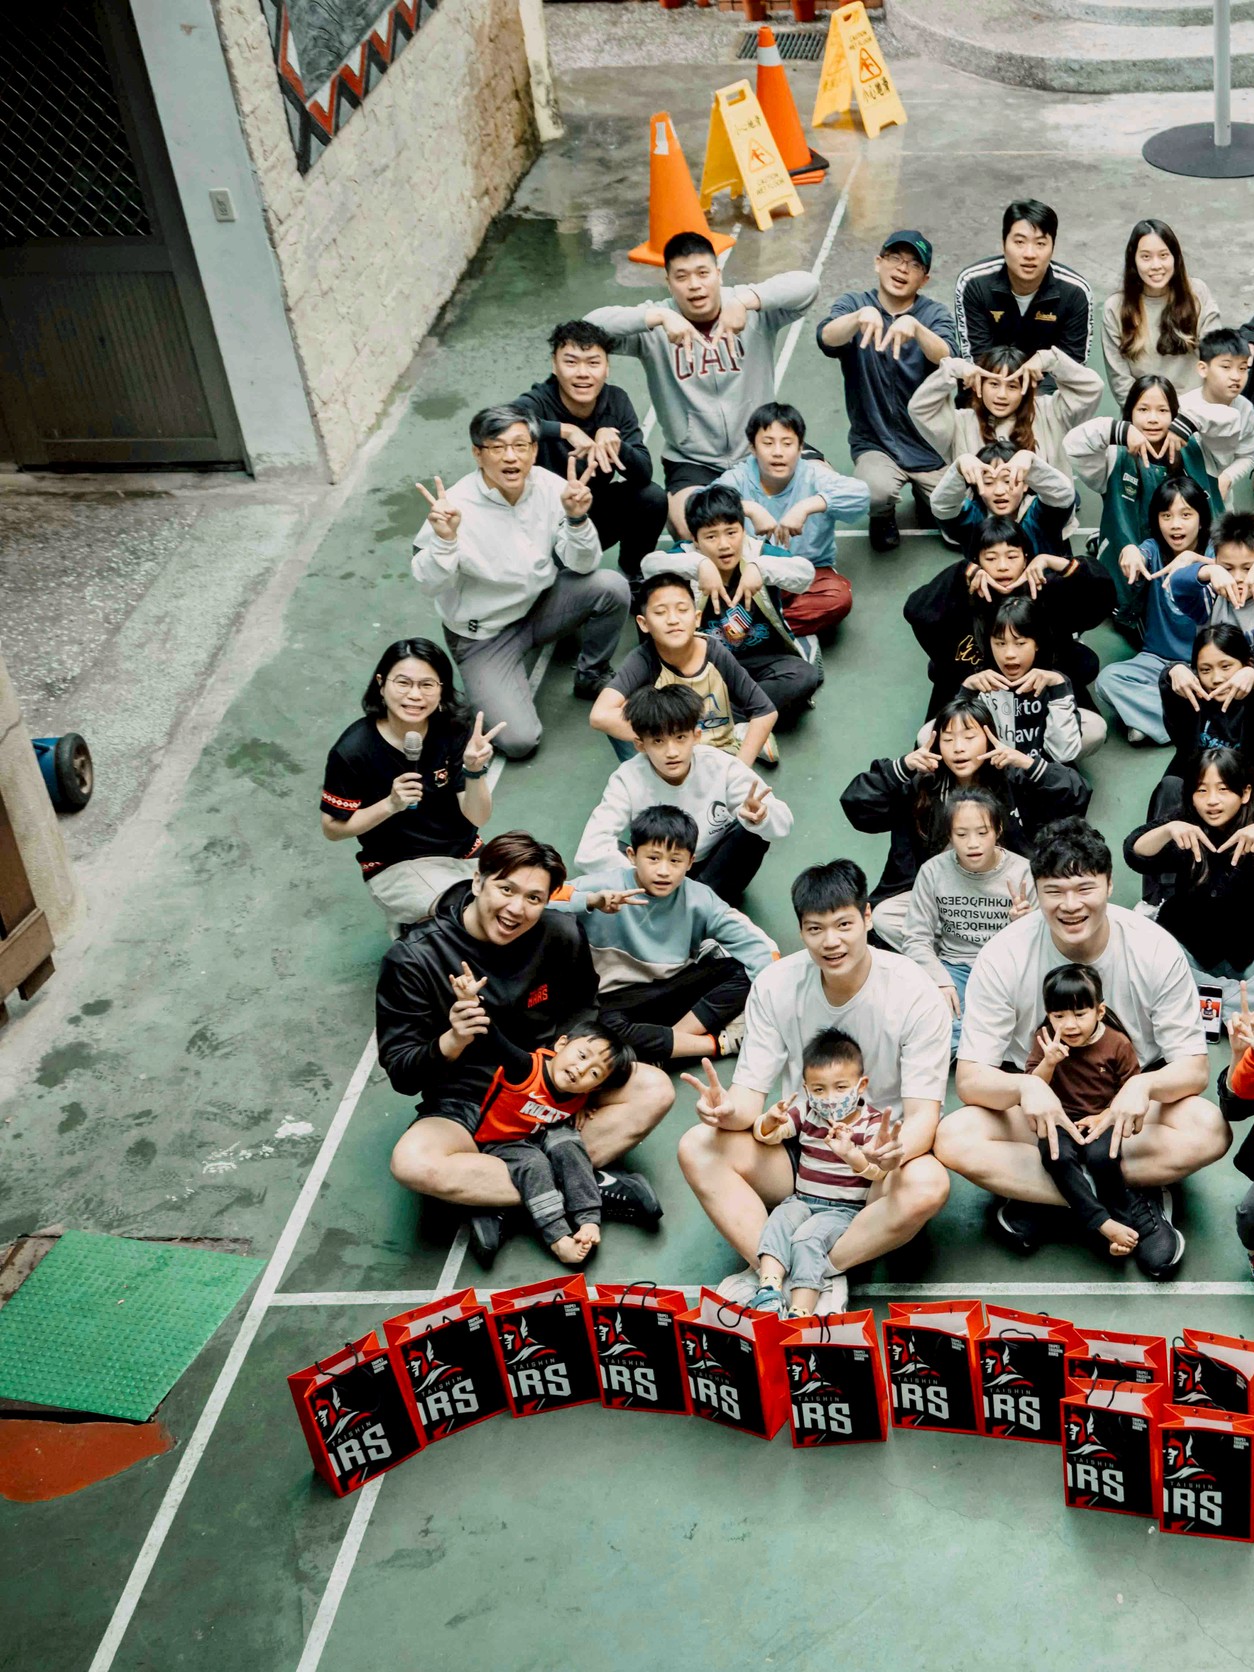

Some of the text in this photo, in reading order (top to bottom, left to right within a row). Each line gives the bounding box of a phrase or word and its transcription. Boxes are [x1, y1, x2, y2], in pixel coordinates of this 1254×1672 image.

[1022, 699, 1042, 715] to
[513, 1358, 556, 1370] TAISHIN
[605, 1358, 645, 1367] TAISHIN
[421, 1376, 462, 1397] TAISHIN
[897, 1376, 938, 1385] TAISHIN
[989, 1387, 1031, 1395] TAISHIN
[331, 1421, 372, 1447] TAISHIN
[1073, 1456, 1115, 1469] TAISHIN
[1170, 1481, 1213, 1490] TAISHIN
